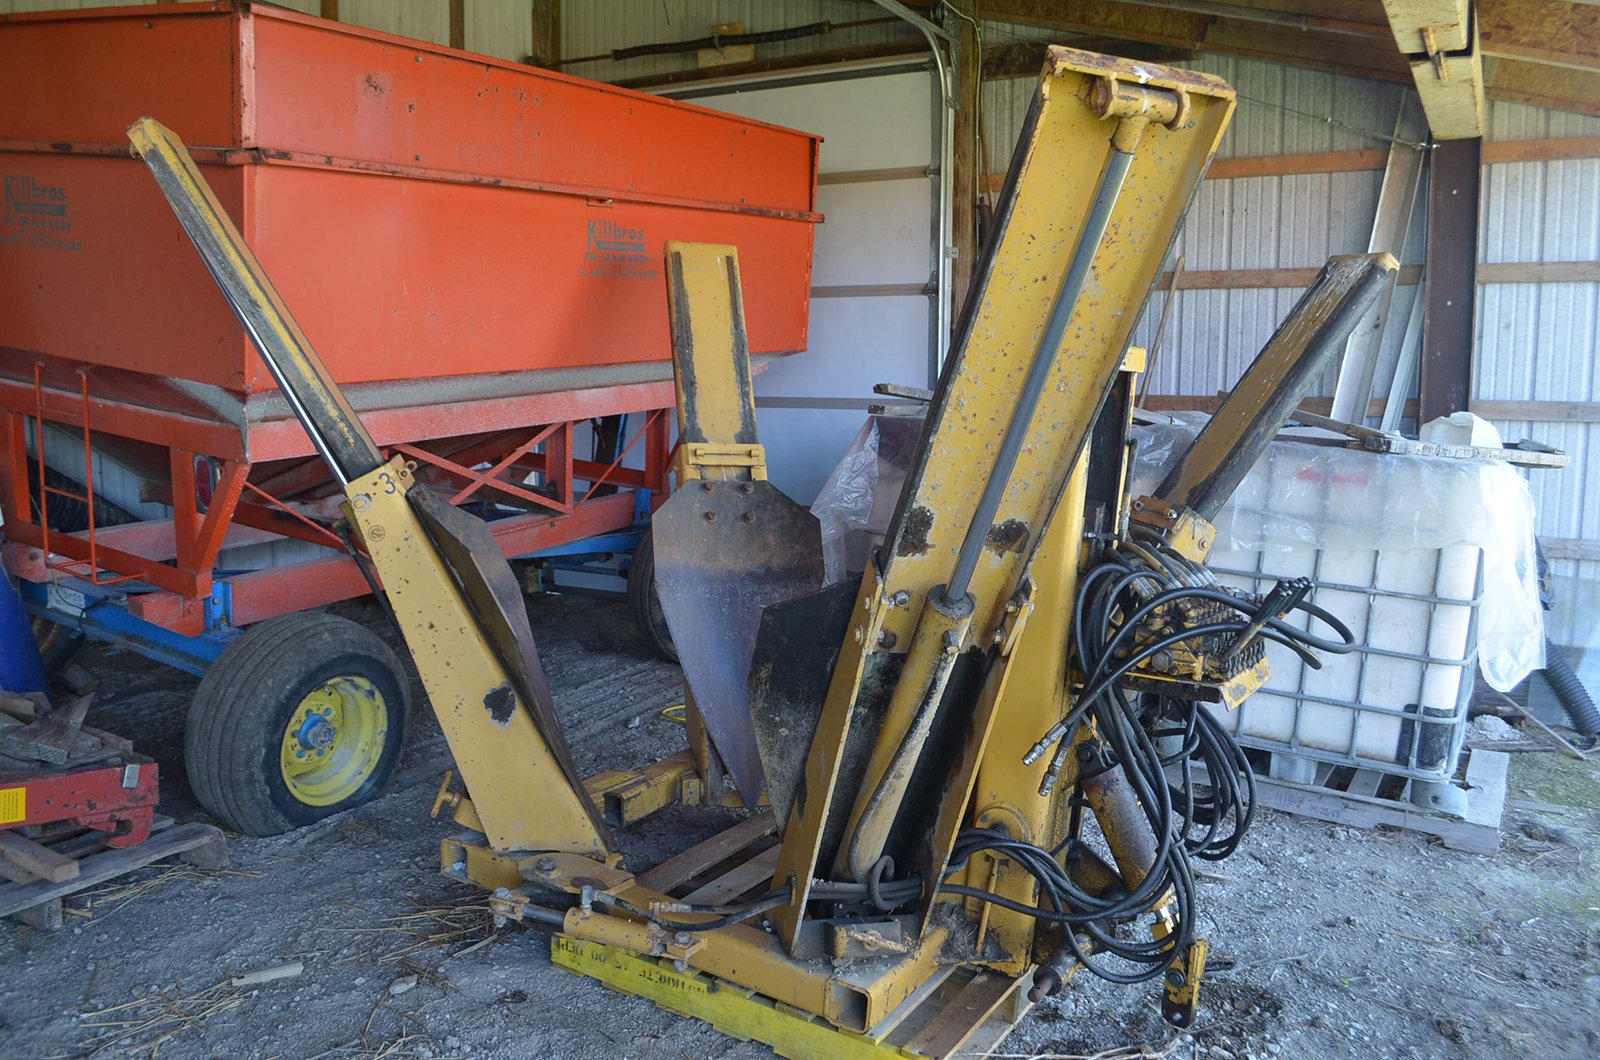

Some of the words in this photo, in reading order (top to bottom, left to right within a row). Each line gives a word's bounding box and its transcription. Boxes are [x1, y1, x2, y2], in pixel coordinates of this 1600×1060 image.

[4, 175, 65, 216] Killbros
[587, 218, 644, 250] Killbros
[379, 472, 396, 494] 3
